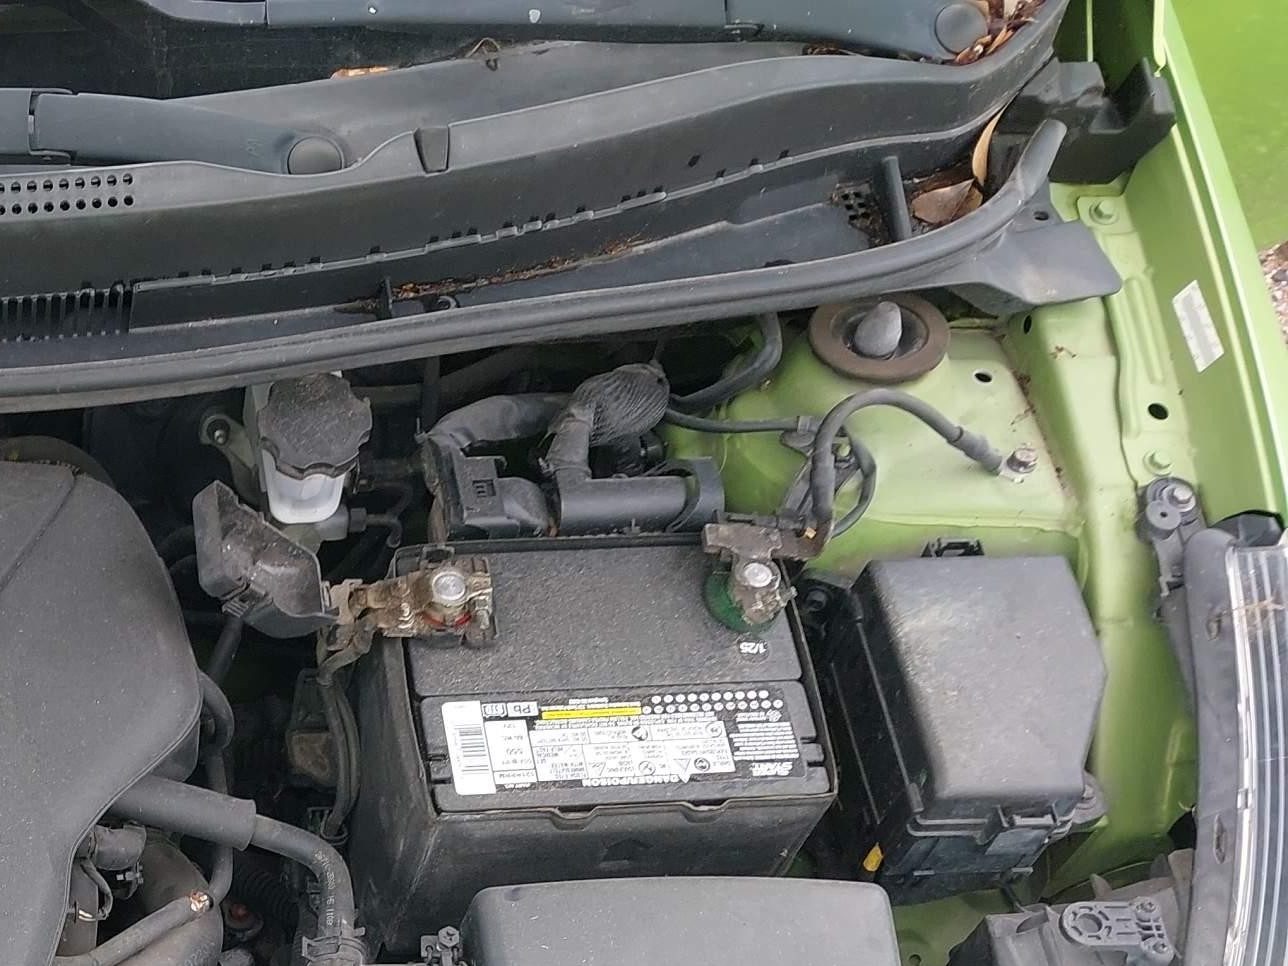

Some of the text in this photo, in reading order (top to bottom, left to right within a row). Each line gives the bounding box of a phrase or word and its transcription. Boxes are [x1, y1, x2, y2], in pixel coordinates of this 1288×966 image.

[739, 641, 767, 654] 1/25
[514, 704, 531, 714] Pb
[582, 775, 680, 788] DANGER/POISON
